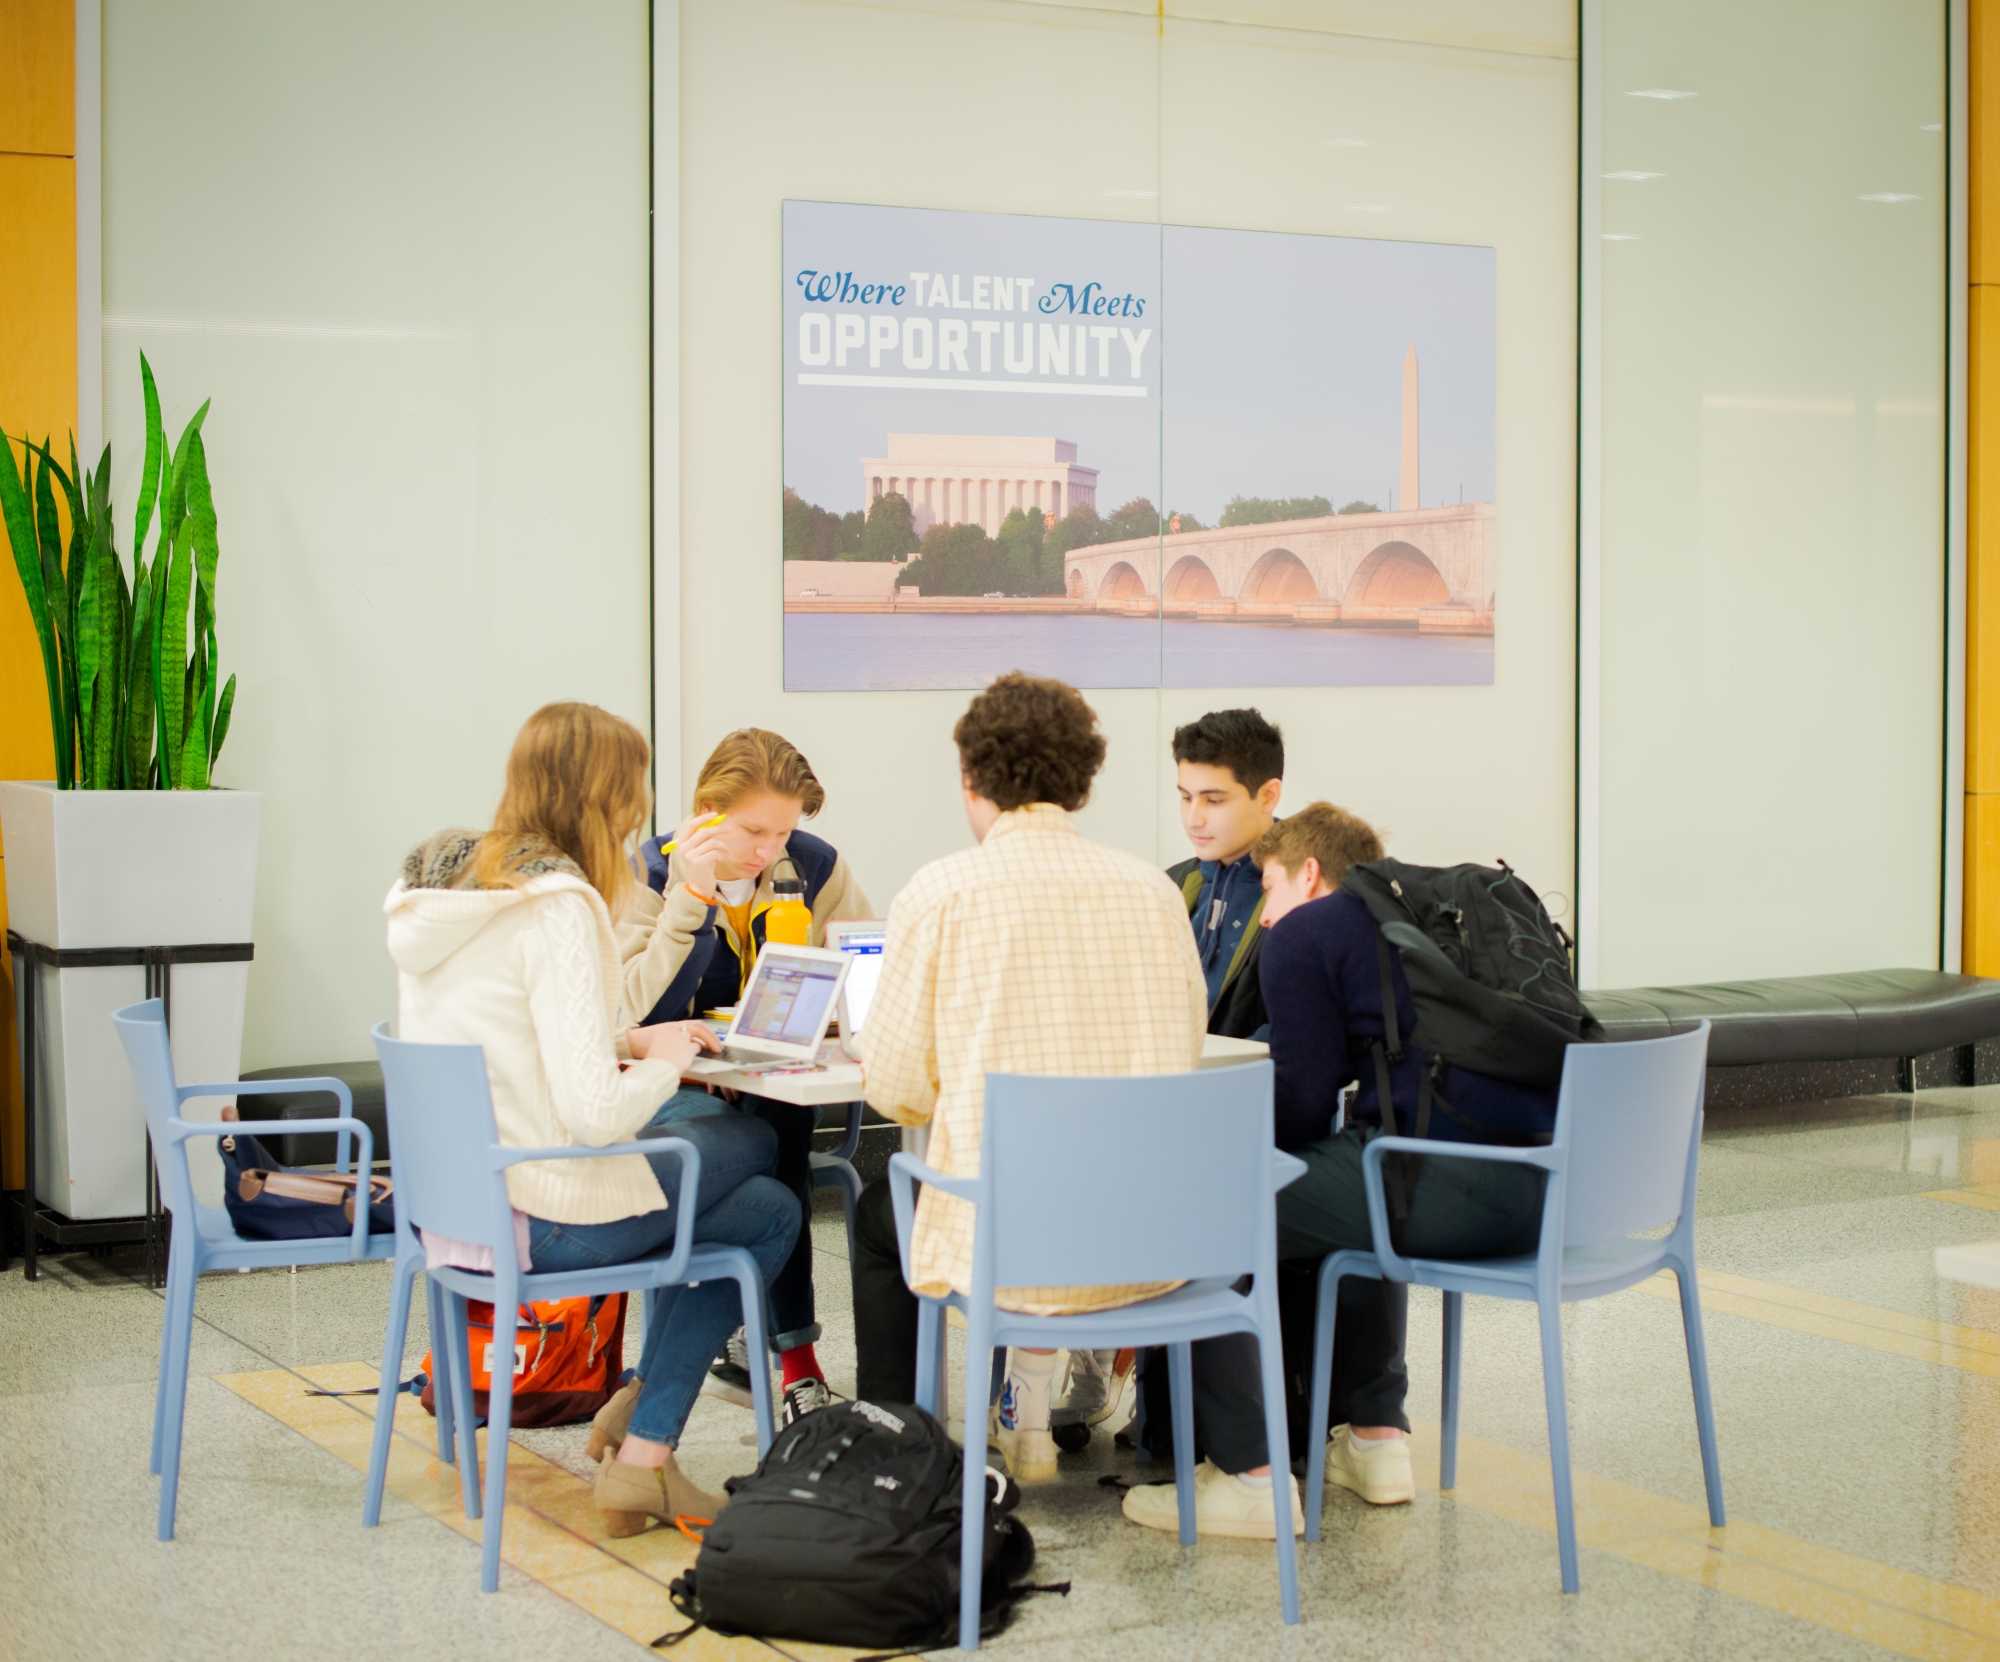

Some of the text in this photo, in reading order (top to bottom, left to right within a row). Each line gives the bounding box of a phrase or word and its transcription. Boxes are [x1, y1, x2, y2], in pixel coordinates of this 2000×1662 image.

[797, 270, 1146, 318] Where TALENT Meets
[799, 312, 1152, 378] OPPORTUNITY
